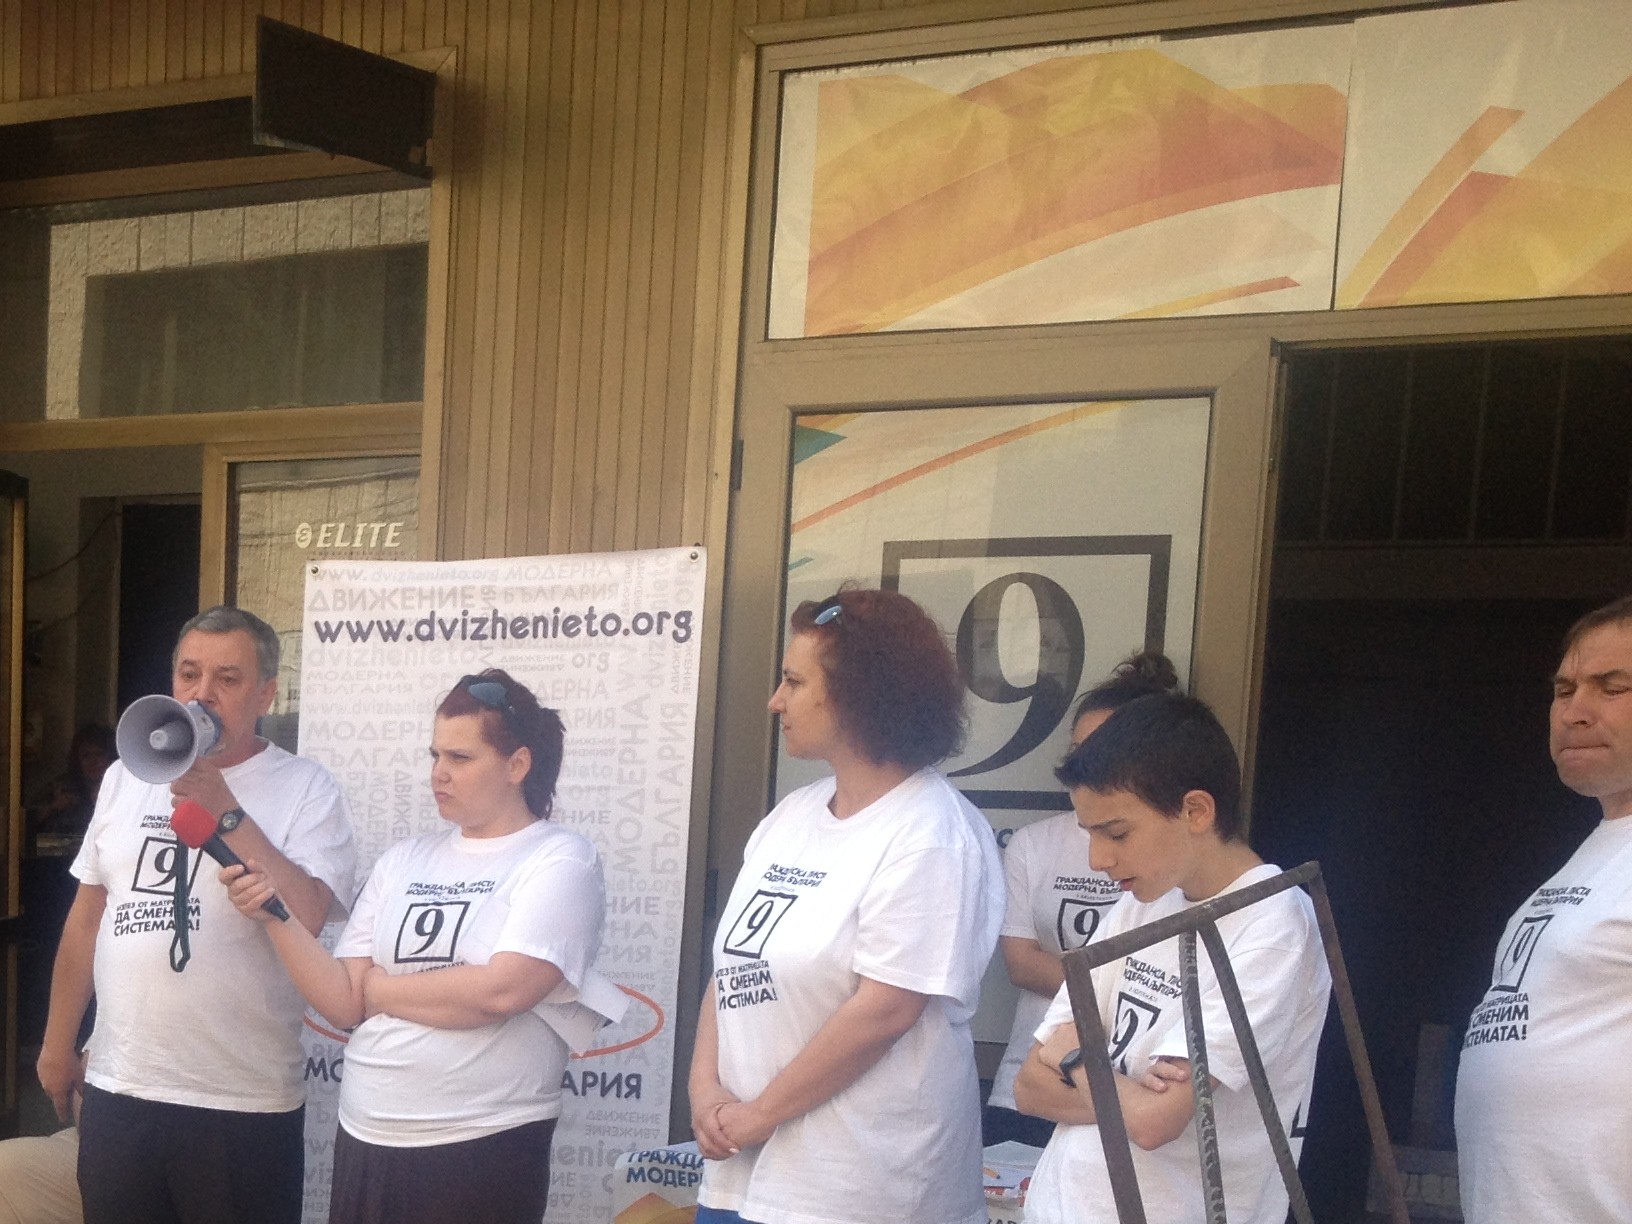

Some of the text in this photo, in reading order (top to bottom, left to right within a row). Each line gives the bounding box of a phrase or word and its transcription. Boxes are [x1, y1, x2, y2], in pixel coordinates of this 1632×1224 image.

[316, 521, 405, 549] ELITE
[308, 585, 476, 612] ДВИЖЕНИЕ
[503, 584, 619, 603] БЪЛГАРИЯ
[314, 605, 693, 644] www.dvizhenieto.org
[947, 572, 1085, 777] 9
[306, 720, 432, 741] МОДЕРН
[153, 846, 177, 888] 9
[1053, 884, 1098, 895] МОДЕРНА
[1054, 876, 1116, 888] ГРАЖДАНСКА
[114, 904, 201, 925] ДА СМЕНМ
[734, 900, 774, 947] 9
[113, 918, 200, 937] СИСТЕМАА!
[409, 908, 445, 955] 9
[1073, 908, 1100, 949] 9
[560, 1070, 642, 1099] АРИЯ
[585, 1110, 662, 1124] ДВИЖЕНИЕ
[628, 1149, 704, 1169] ГРАЖДА
[626, 1166, 702, 1187] МОДЕР
